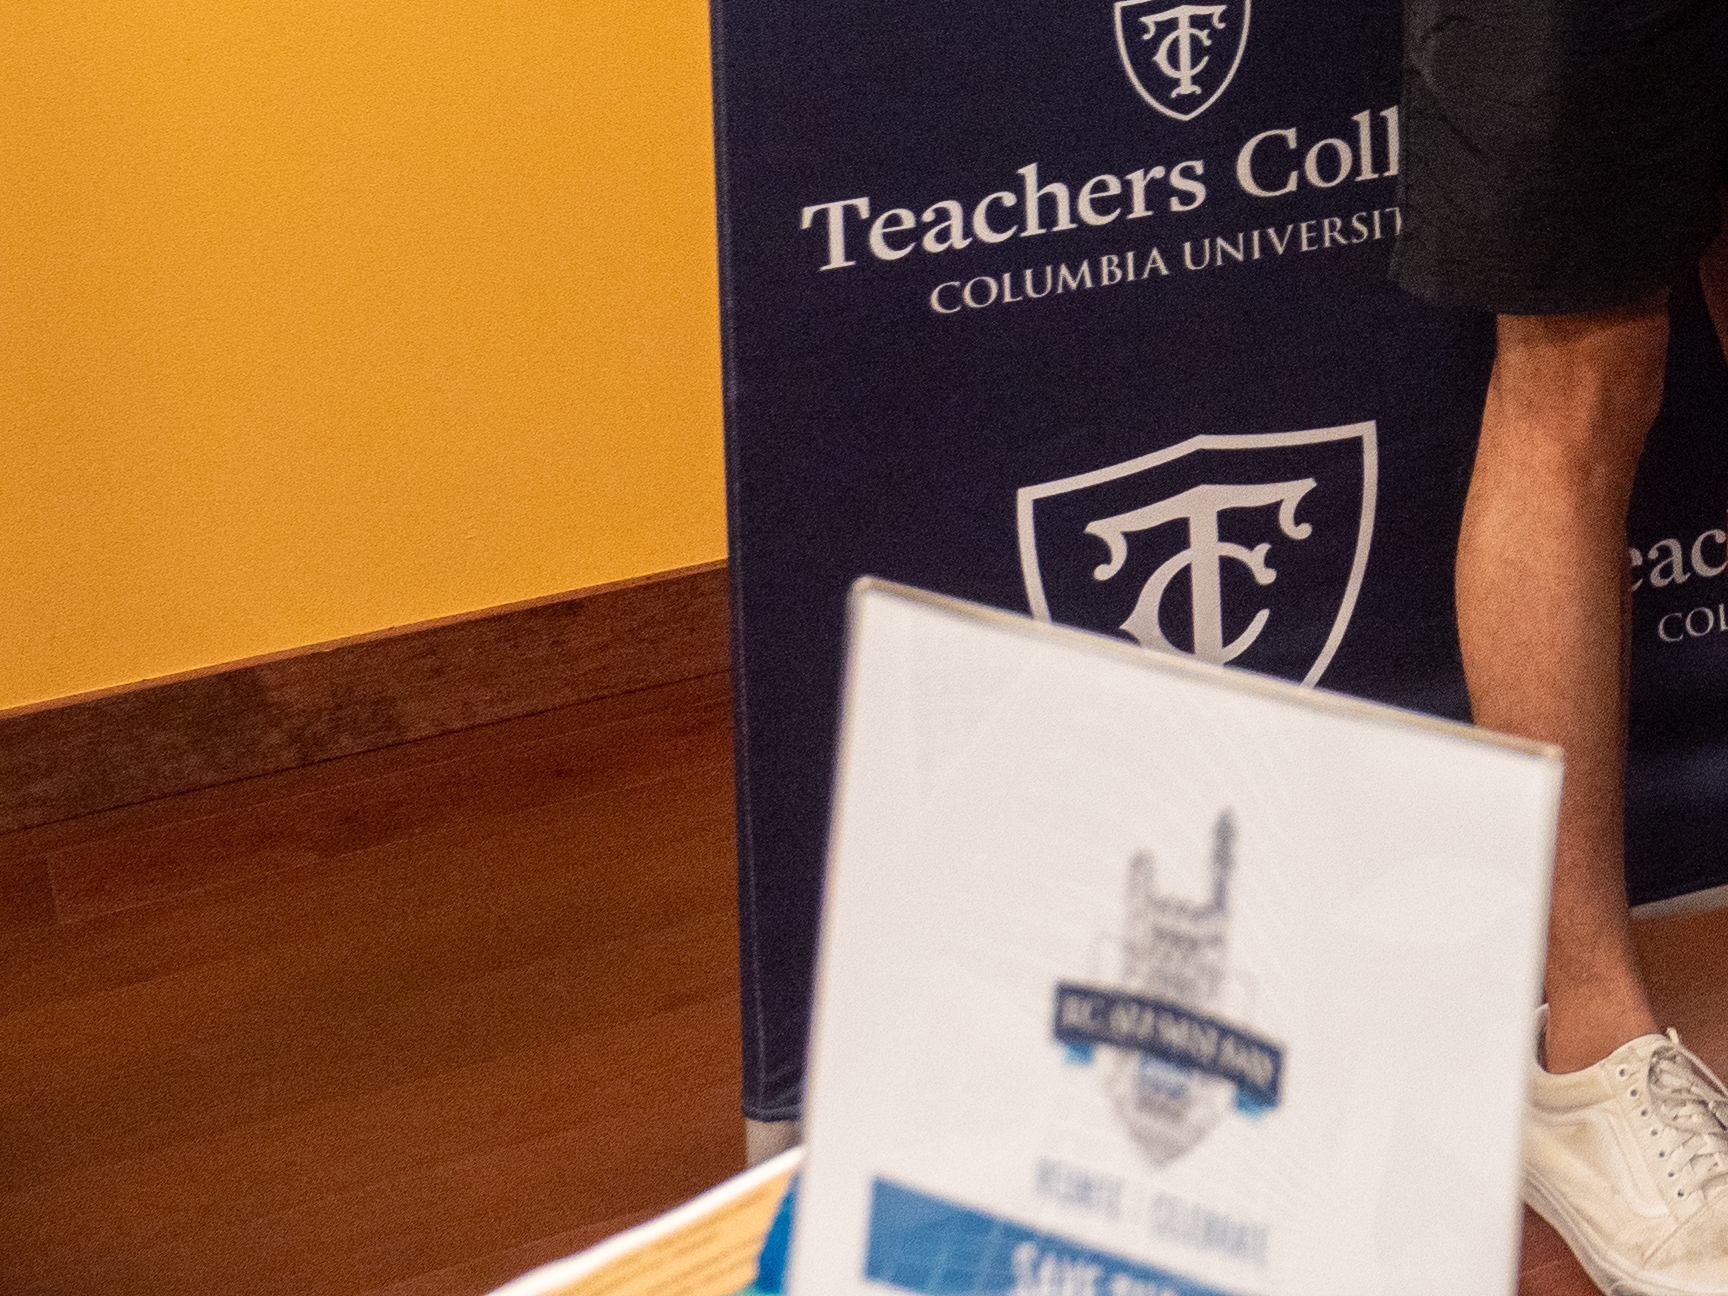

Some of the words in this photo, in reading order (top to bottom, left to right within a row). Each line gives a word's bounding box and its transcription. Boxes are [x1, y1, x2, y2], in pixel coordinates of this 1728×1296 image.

[801, 153, 1209, 271] Teachers
[1236, 105, 1398, 200] Coll
[929, 248, 1170, 316] COLUMBIA
